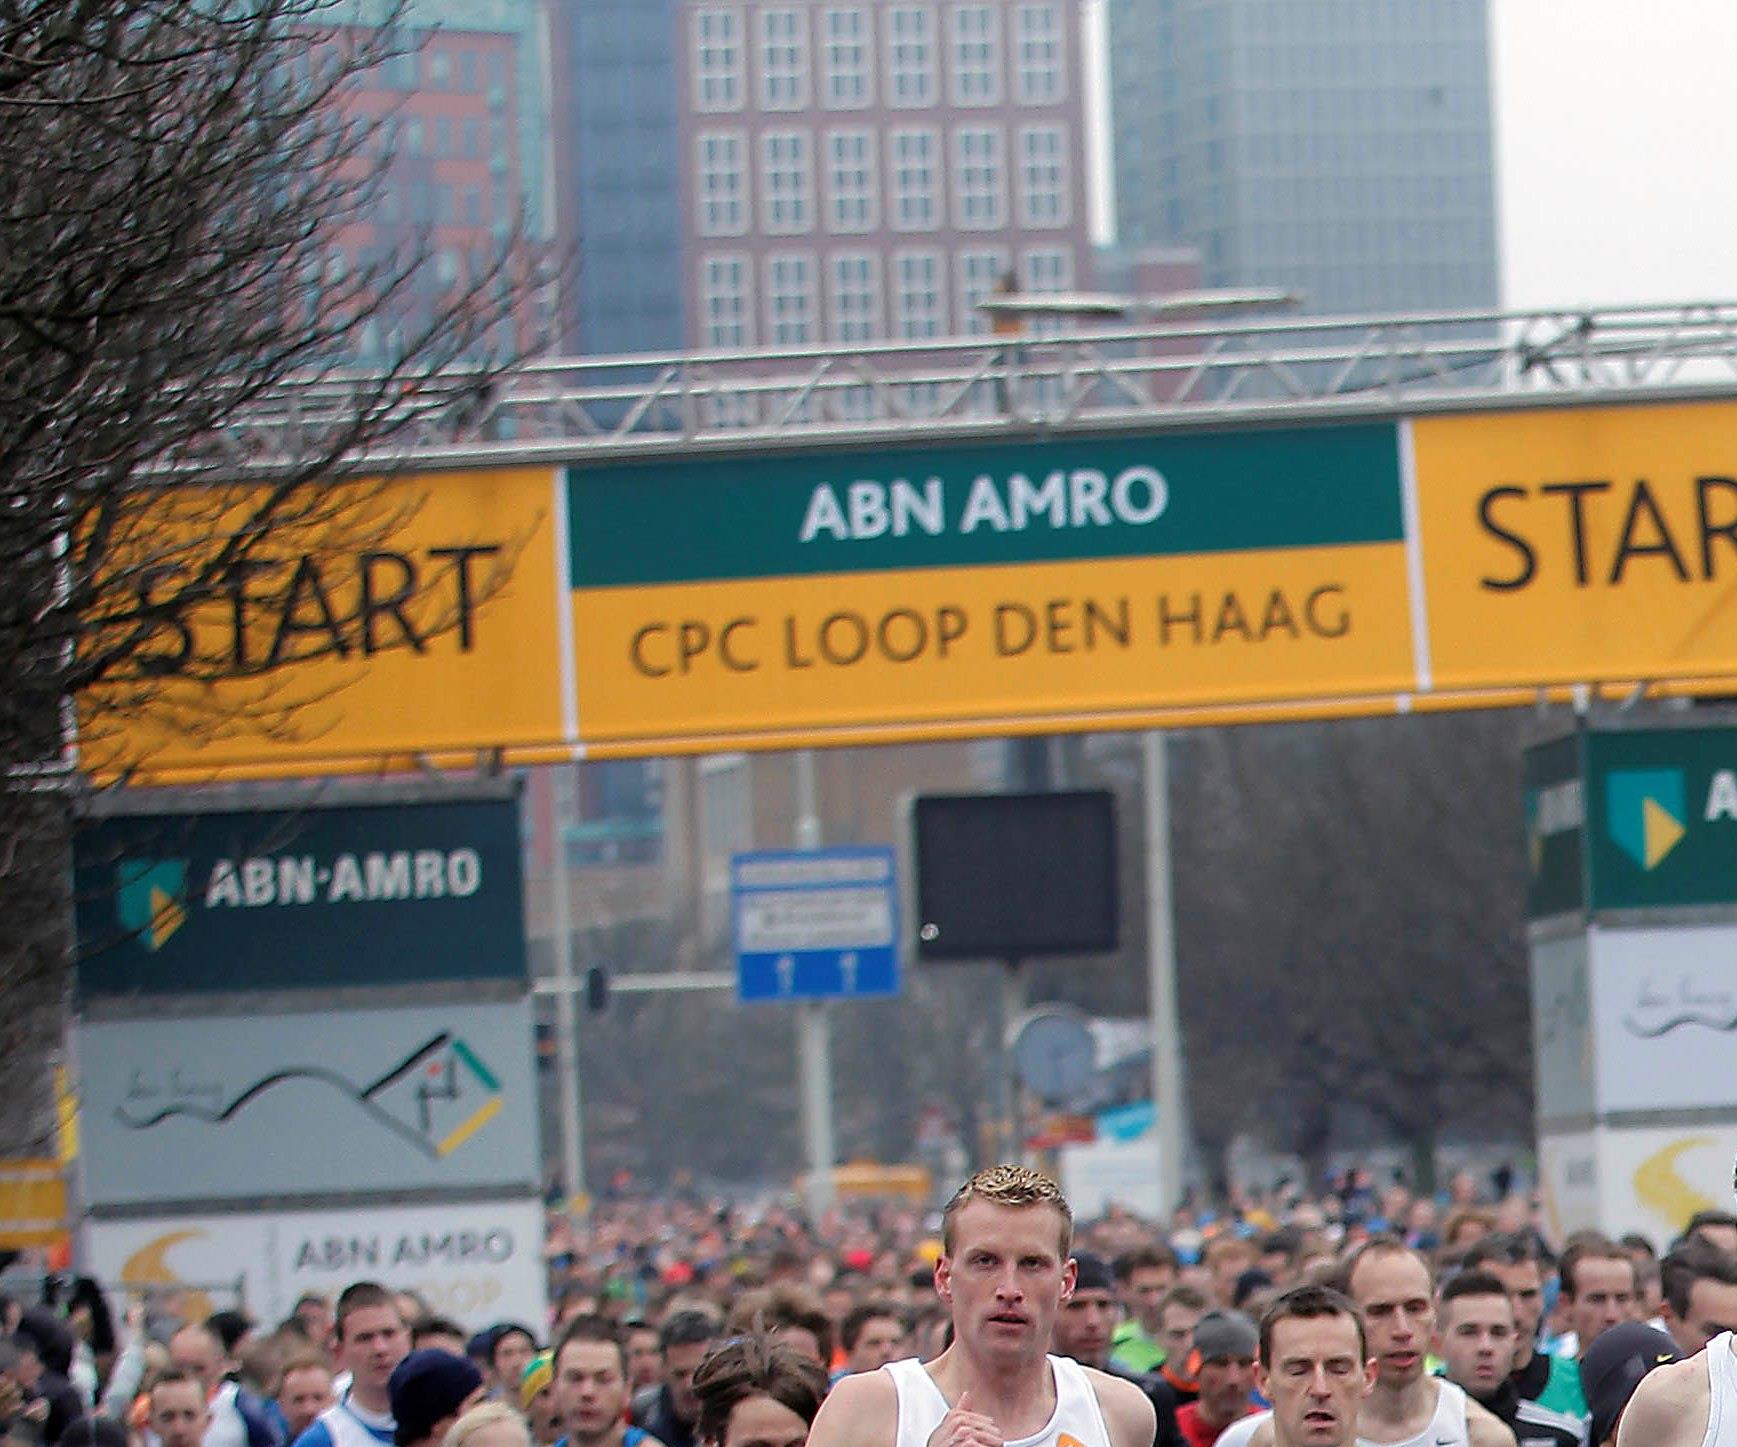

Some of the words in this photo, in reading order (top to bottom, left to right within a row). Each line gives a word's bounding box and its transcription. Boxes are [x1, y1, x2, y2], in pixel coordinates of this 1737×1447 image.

[800, 474, 945, 544] ABN
[959, 464, 1170, 536] AMRO
[132, 543, 500, 676] START
[630, 614, 761, 680] CPC
[783, 604, 970, 672] LOOP
[993, 597, 1133, 660] DEN
[1158, 583, 1353, 648] HAAG
[294, 1233, 380, 1272] ABN
[393, 1226, 514, 1265] AMRO
